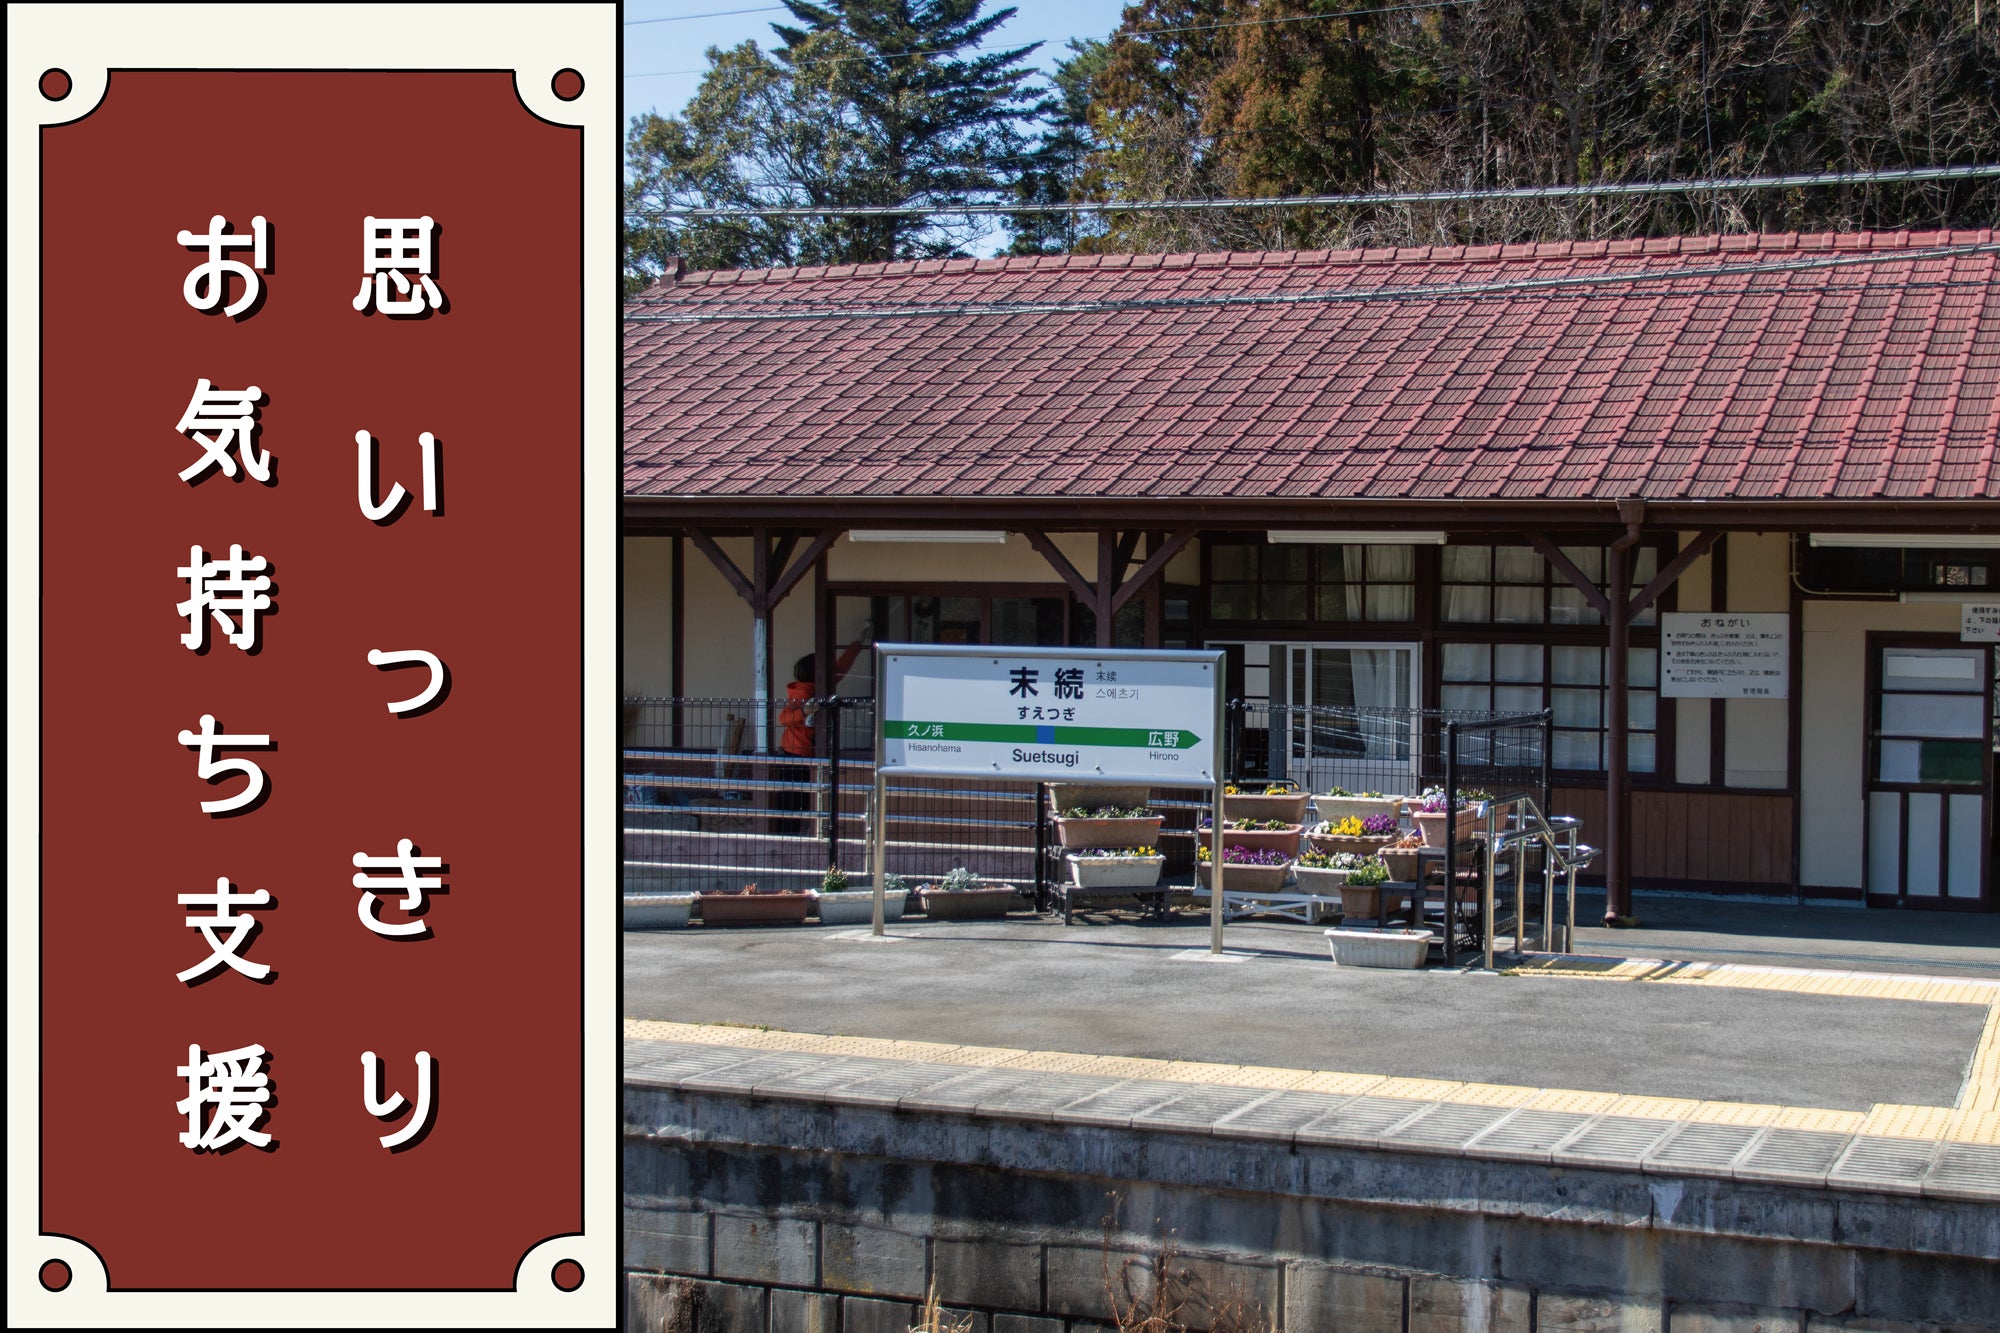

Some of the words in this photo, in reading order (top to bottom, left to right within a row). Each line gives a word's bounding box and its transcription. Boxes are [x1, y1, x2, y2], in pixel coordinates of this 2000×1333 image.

[1700, 618, 1751, 628] おねがい
[1095, 688, 1140, 701] 스에츠기
[1017, 705, 1076, 722] すえつぎ
[908, 724, 944, 738] 久ノ浜
[1148, 731, 1180, 749] 広野
[908, 743, 962, 754] Hisanohama
[1012, 748, 1080, 767] Suetsugi
[1149, 751, 1180, 762] Hirono
